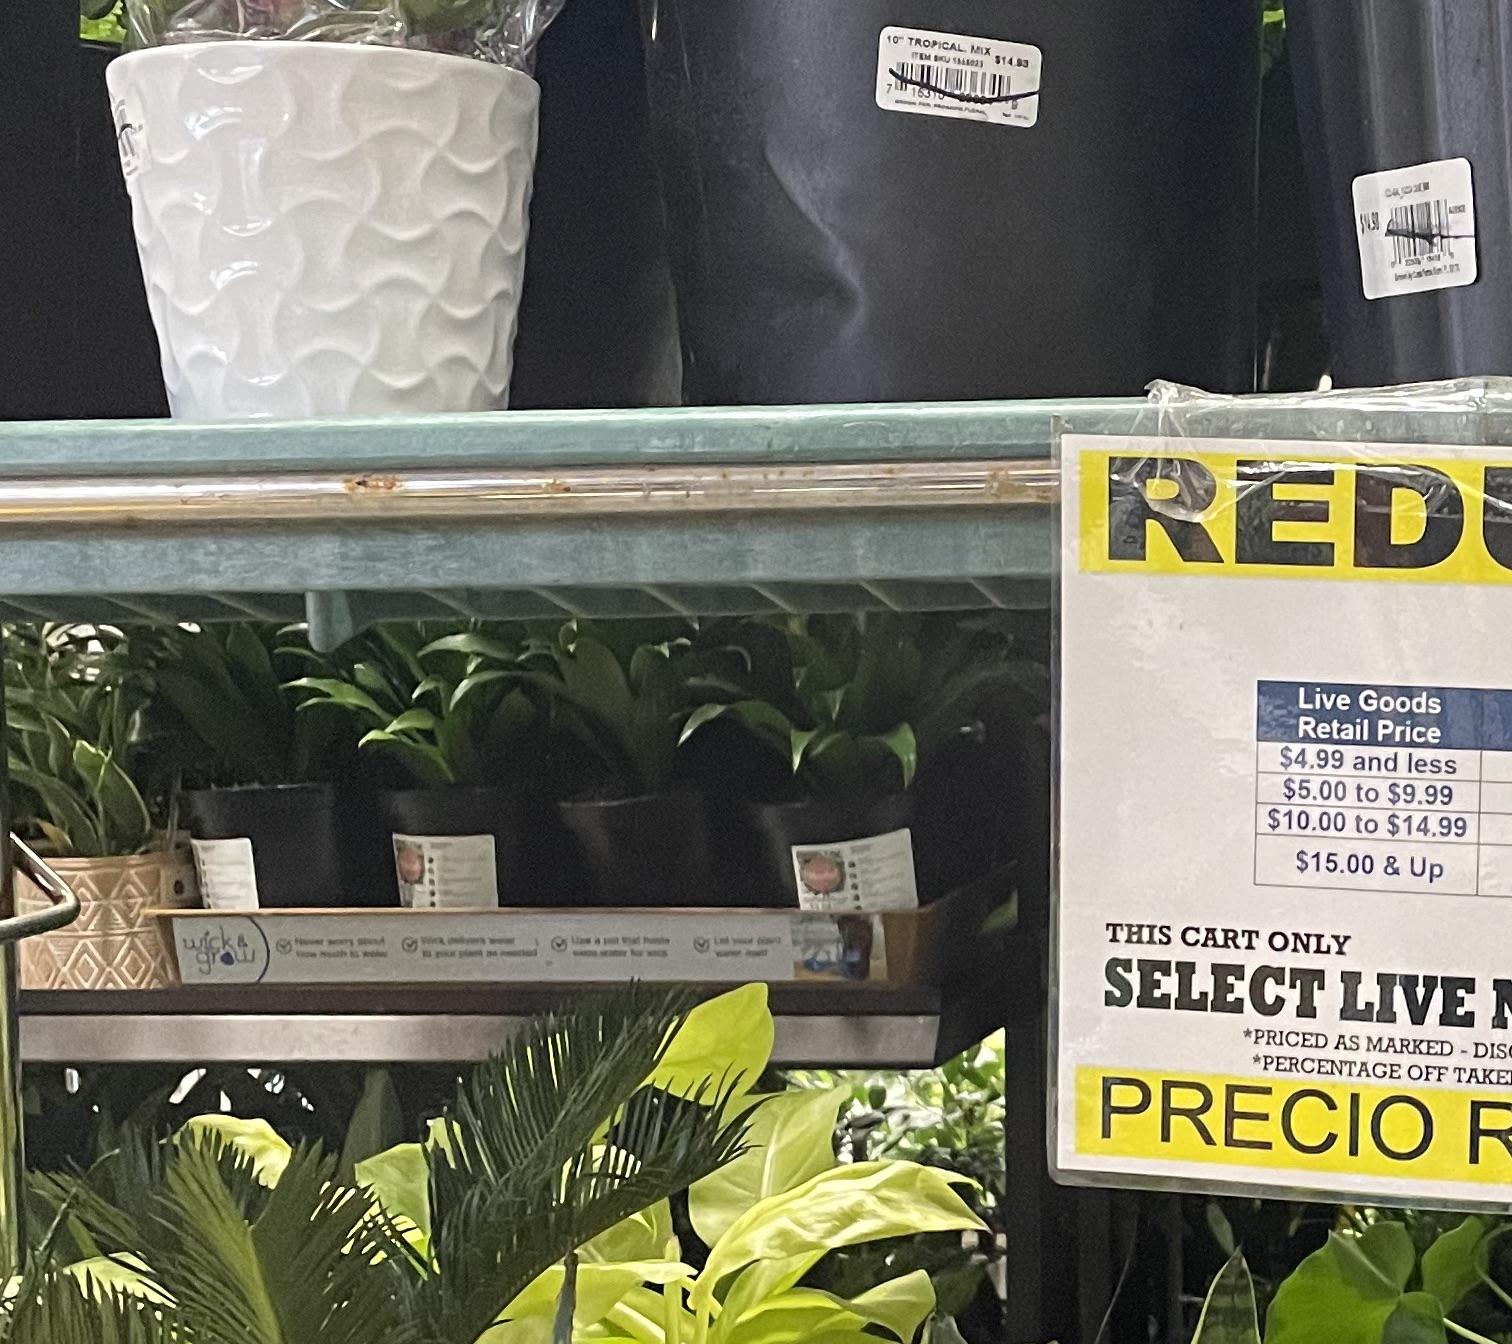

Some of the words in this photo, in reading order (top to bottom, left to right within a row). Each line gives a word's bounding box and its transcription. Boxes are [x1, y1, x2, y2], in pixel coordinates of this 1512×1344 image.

[908, 36, 967, 54] TROPICAL
[970, 45, 991, 56] MIX
[1299, 687, 1350, 711] Live
[1358, 689, 1441, 714] Goods
[1298, 717, 1368, 741] Retail
[1377, 720, 1441, 743] Price
[1280, 745, 1344, 771] $4.99
[1352, 751, 1398, 772] and
[1408, 752, 1457, 774] less
[1283, 777, 1347, 802] $5.00
[1356, 783, 1379, 803] to
[1387, 782, 1453, 806] $9.99
[1268, 807, 1346, 832] $10.00
[1355, 814, 1379, 834] to
[1387, 812, 1467, 838] $14.99
[1296, 849, 1375, 875] $15.00
[1383, 855, 1401, 876] &
[1410, 856, 1444, 883] Up
[183, 925, 232, 953] wick
[1105, 922, 1172, 946] THIS
[1180, 926, 1259, 951] CART
[1269, 931, 1352, 956] ONLY
[1104, 956, 1325, 1019] SELECT
[1340, 971, 1476, 1029] LIVE
[1334, 1034, 1361, 1052] AS
[1366, 1036, 1454, 1057] MARKED
[1407, 1064, 1449, 1082] OFF
[1101, 1076, 1434, 1160] PRECIO
